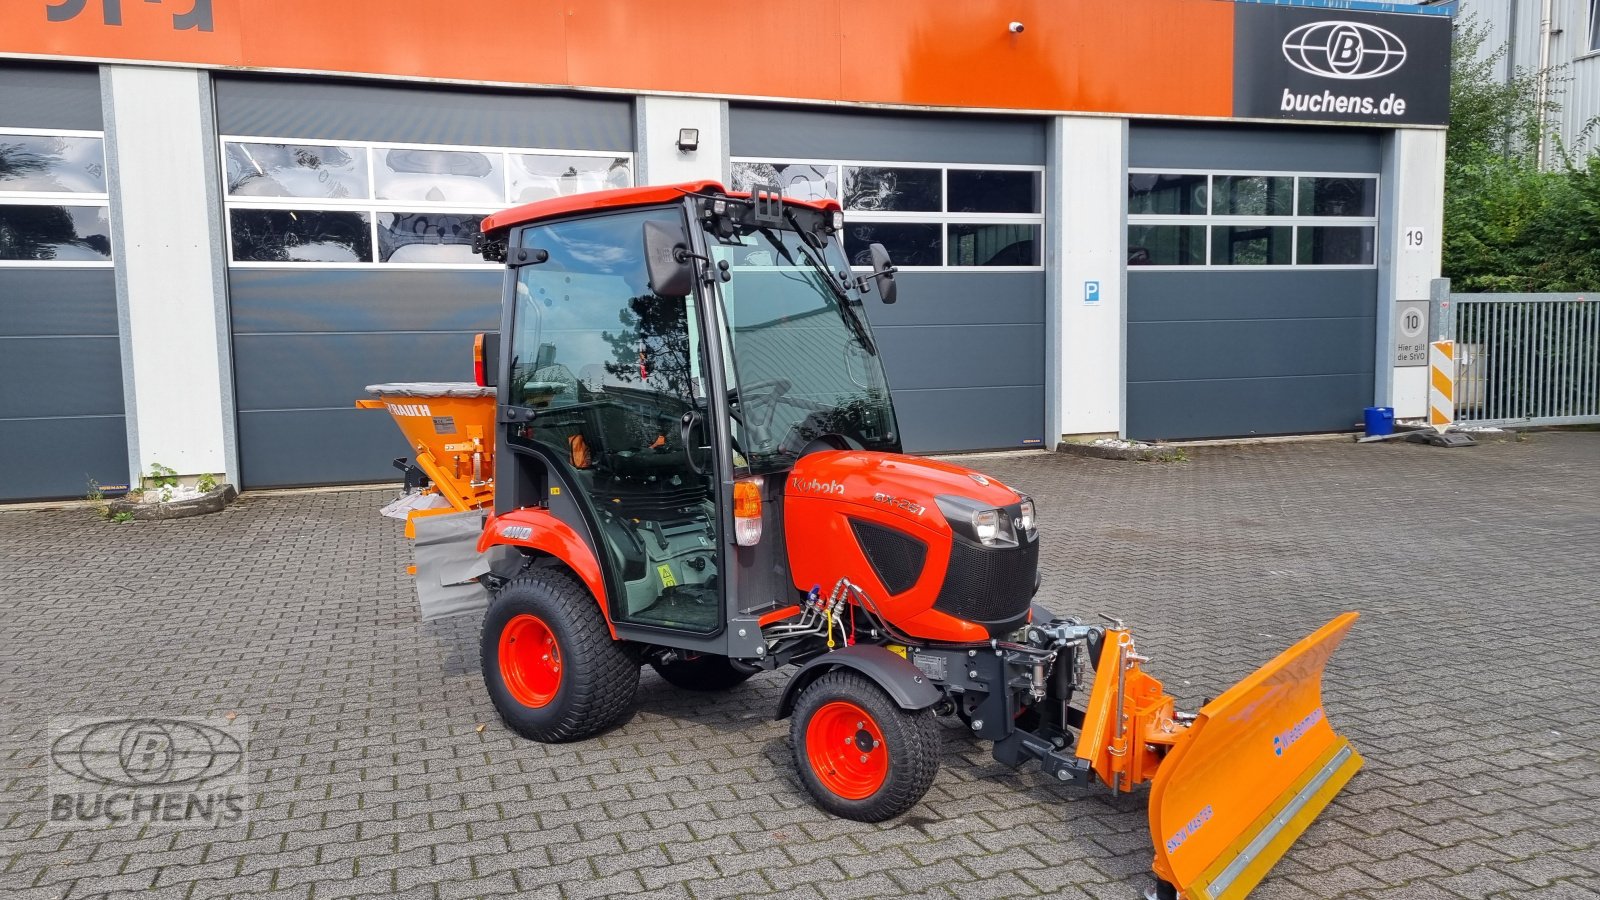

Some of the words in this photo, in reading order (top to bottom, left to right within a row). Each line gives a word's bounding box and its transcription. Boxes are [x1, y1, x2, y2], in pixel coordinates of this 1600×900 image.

[1280, 88, 1406, 115] buchens.de
[1406, 230, 1423, 246] 19
[1086, 282, 1098, 300] P
[1406, 315, 1418, 330] 10
[1398, 343, 1412, 351] Hier
[1415, 343, 1425, 352] gilt
[1397, 352, 1408, 361] die
[389, 403, 432, 416] RAUCH
[792, 477, 845, 494] Kubota
[502, 526, 532, 540] 4WD
